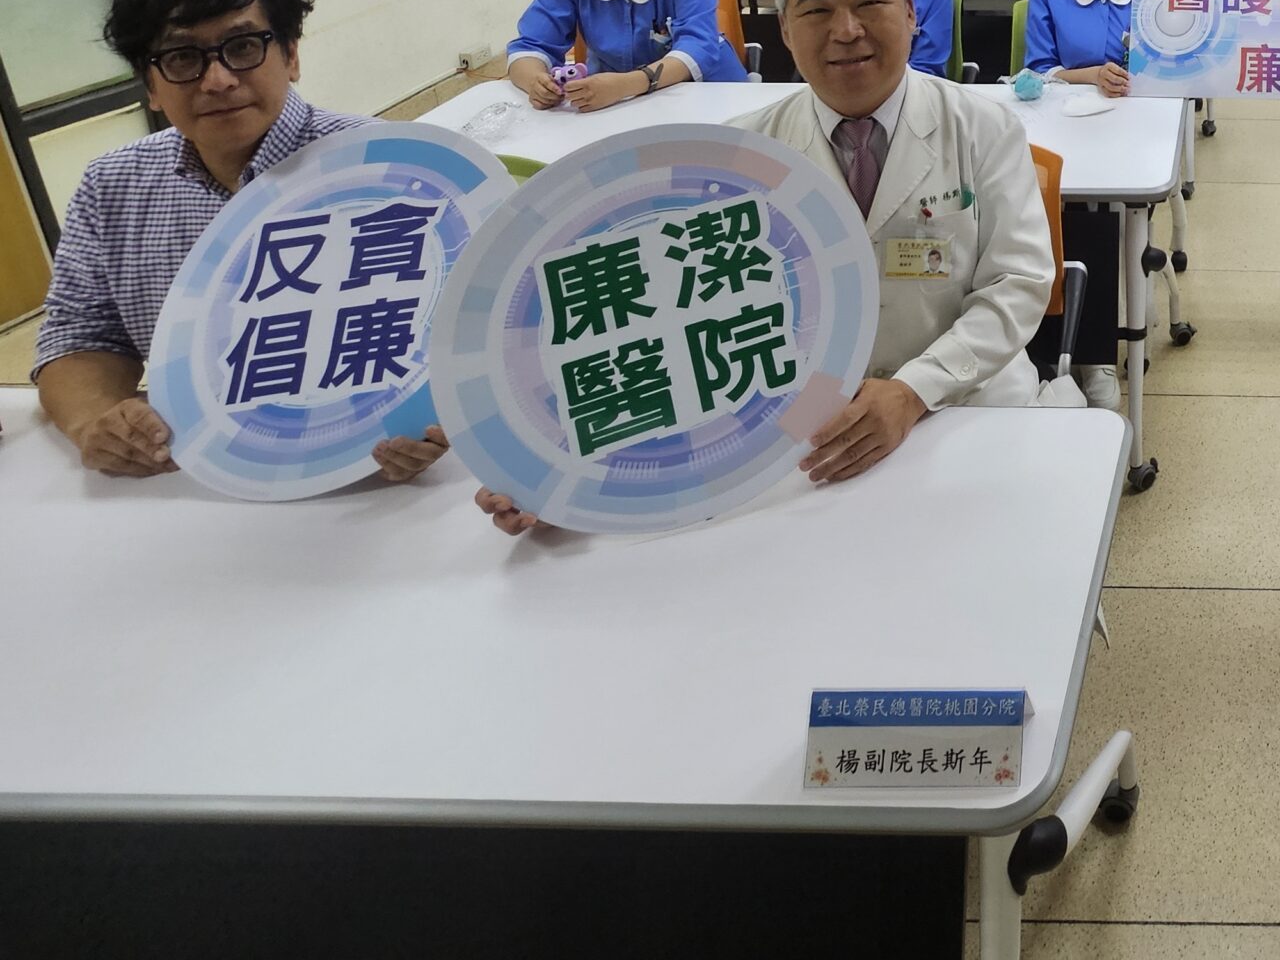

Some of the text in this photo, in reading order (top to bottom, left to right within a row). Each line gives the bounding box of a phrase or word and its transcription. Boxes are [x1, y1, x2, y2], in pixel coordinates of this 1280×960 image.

[239, 202, 440, 304] 反貪
[543, 199, 773, 346] 廉潔
[224, 297, 420, 406] 倡廉
[560, 301, 797, 458] 醫院
[817, 696, 1017, 718] 臺北榮民總醫院桃園分院
[834, 746, 993, 775] 楊副院長斯年
